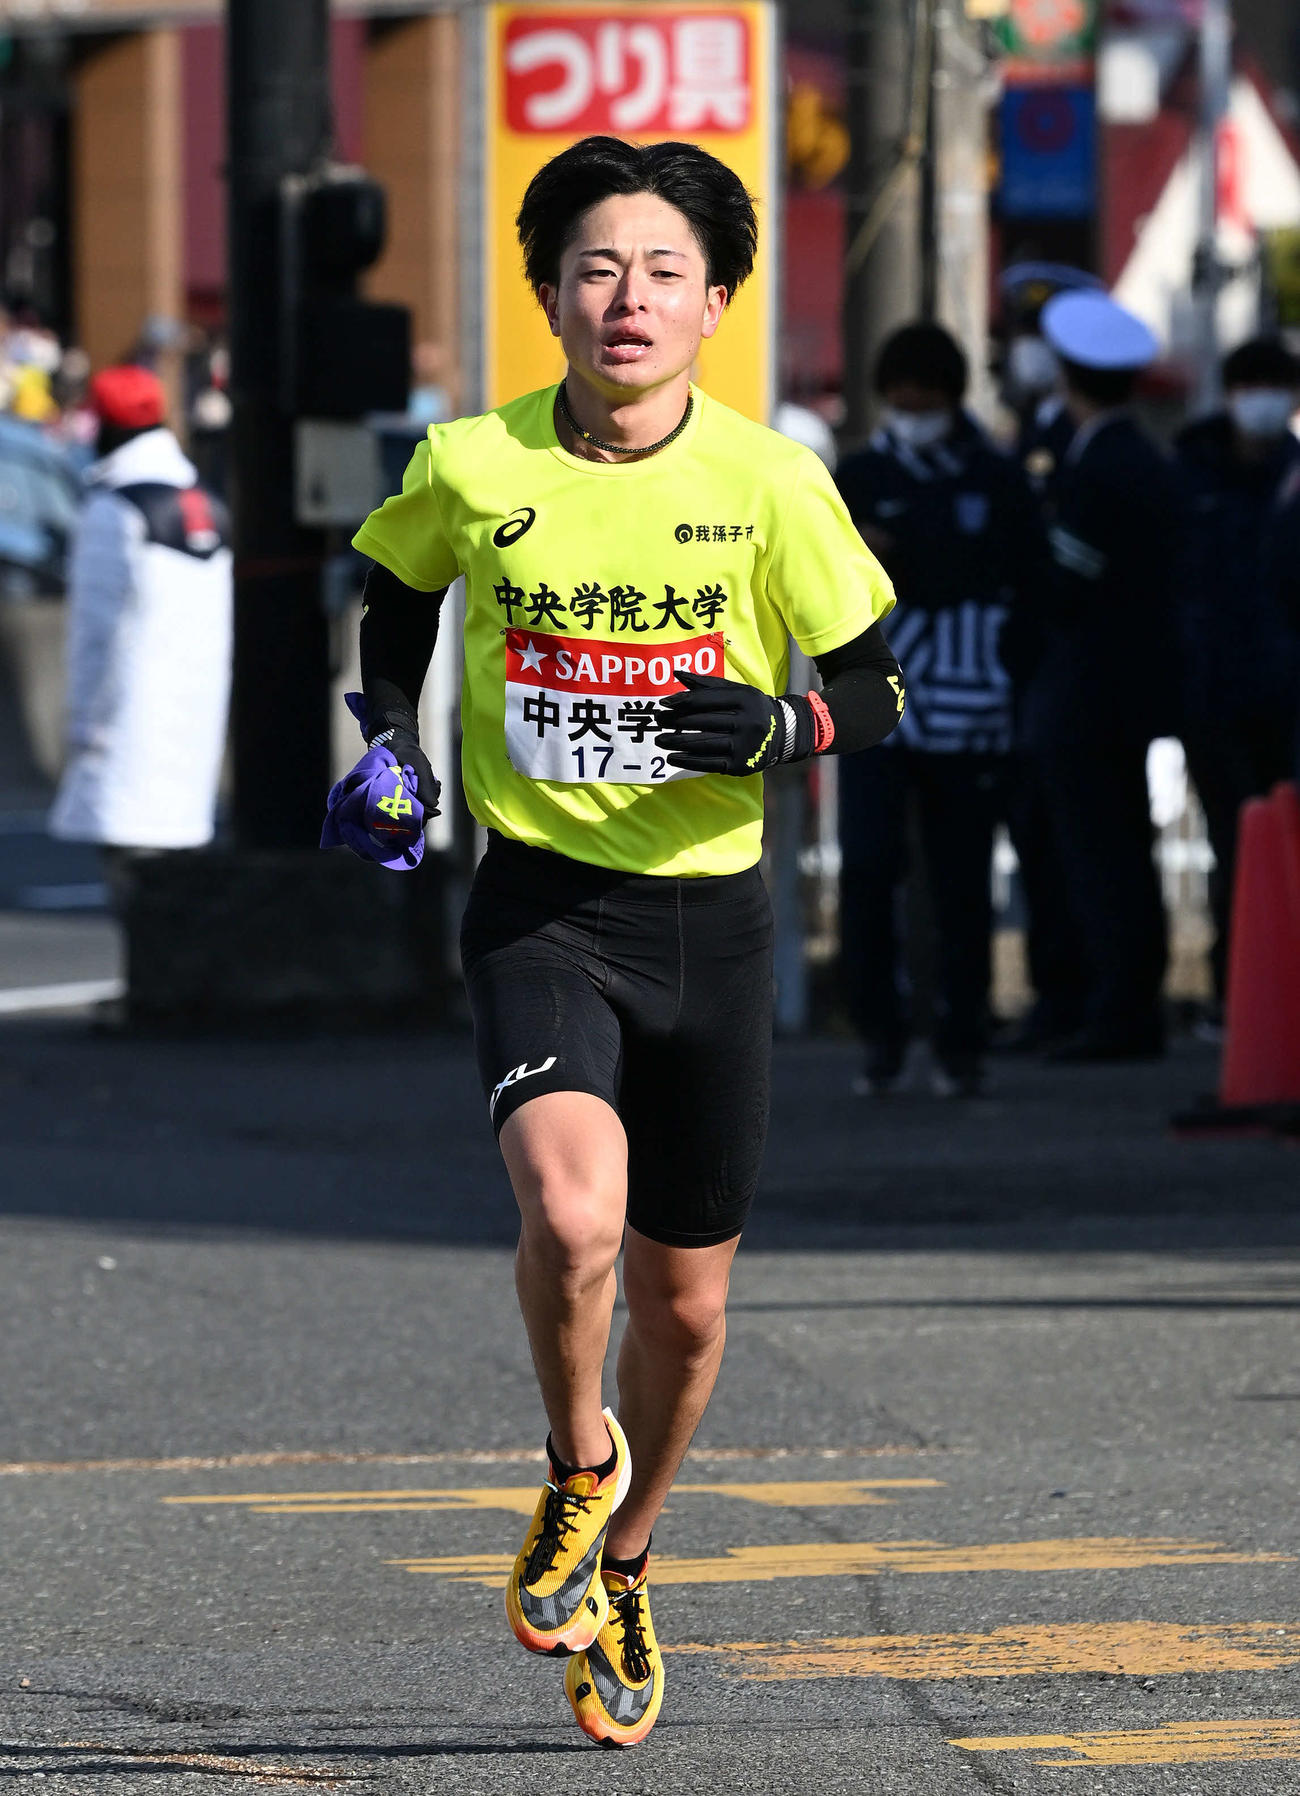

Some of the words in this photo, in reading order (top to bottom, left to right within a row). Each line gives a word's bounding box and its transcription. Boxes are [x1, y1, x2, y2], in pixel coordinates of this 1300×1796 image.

[509, 20, 749, 128] つり具
[493, 576, 728, 632] 中央学院大学
[555, 646, 716, 686] SAPPORO
